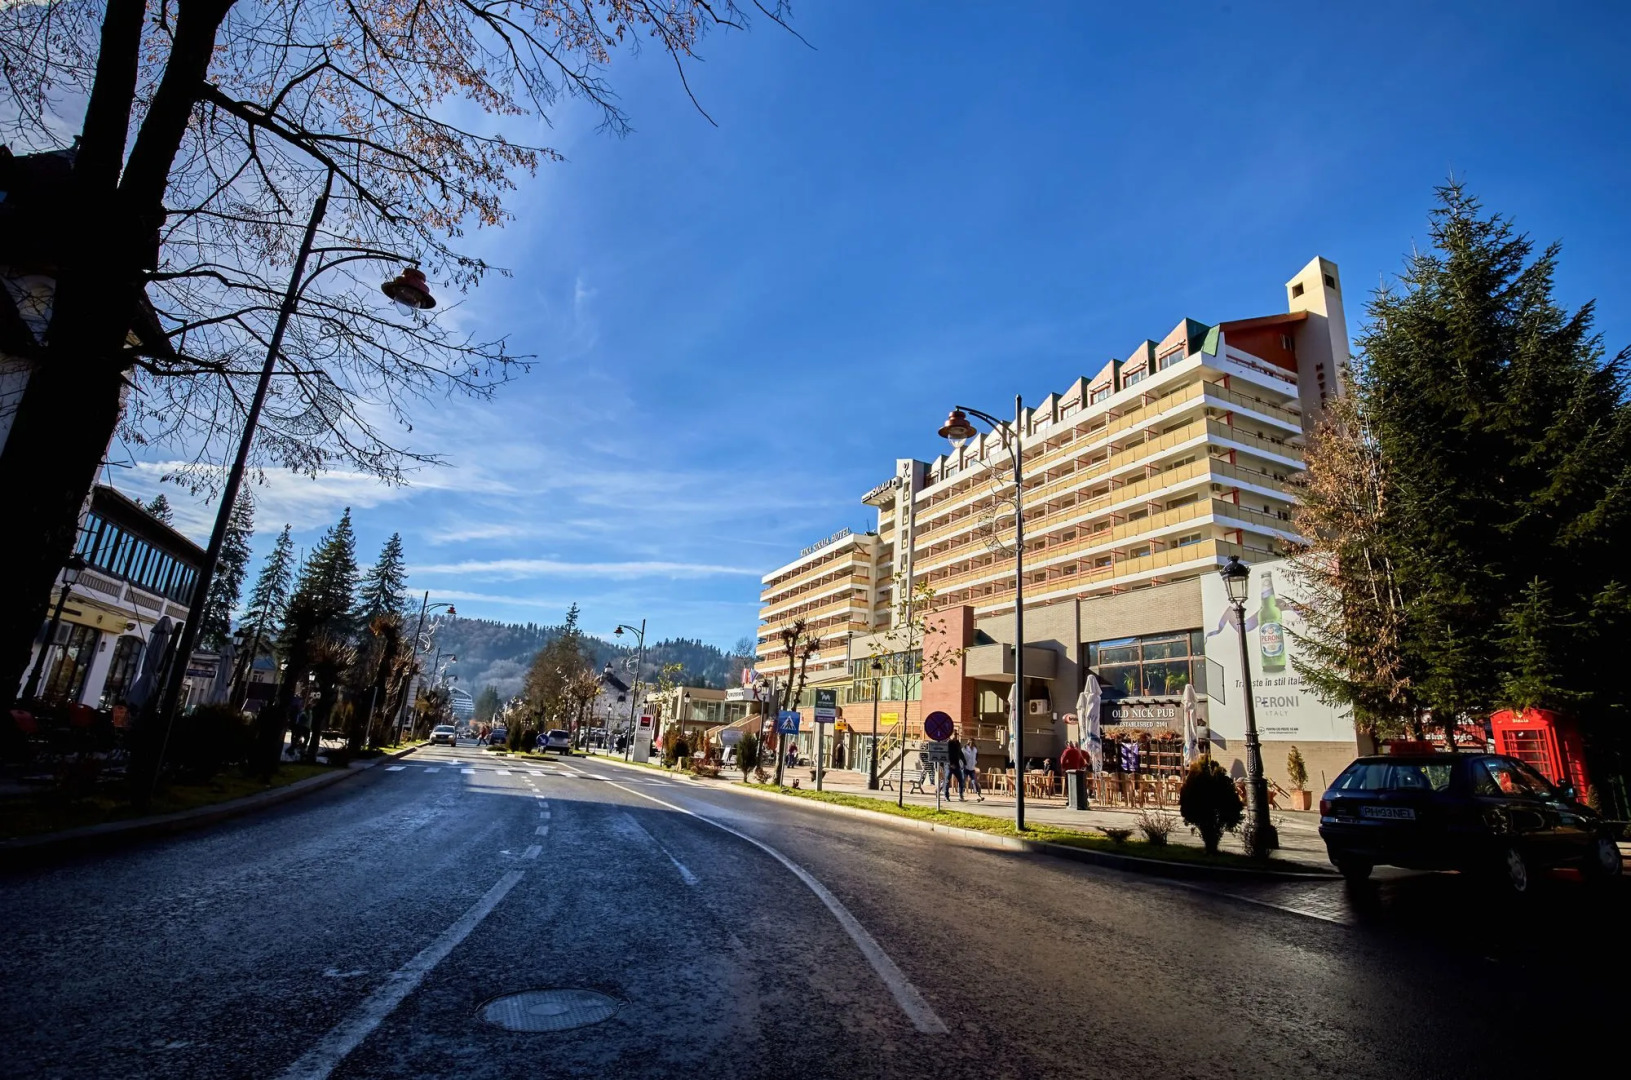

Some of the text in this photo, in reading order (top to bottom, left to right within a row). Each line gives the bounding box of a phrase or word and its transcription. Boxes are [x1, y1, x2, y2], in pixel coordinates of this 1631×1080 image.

[831, 526, 851, 543] HOTEL
[1274, 676, 1286, 686] stil
[1255, 695, 1299, 708] PERONI
[1112, 708, 1175, 718] OLD NICK PUB
